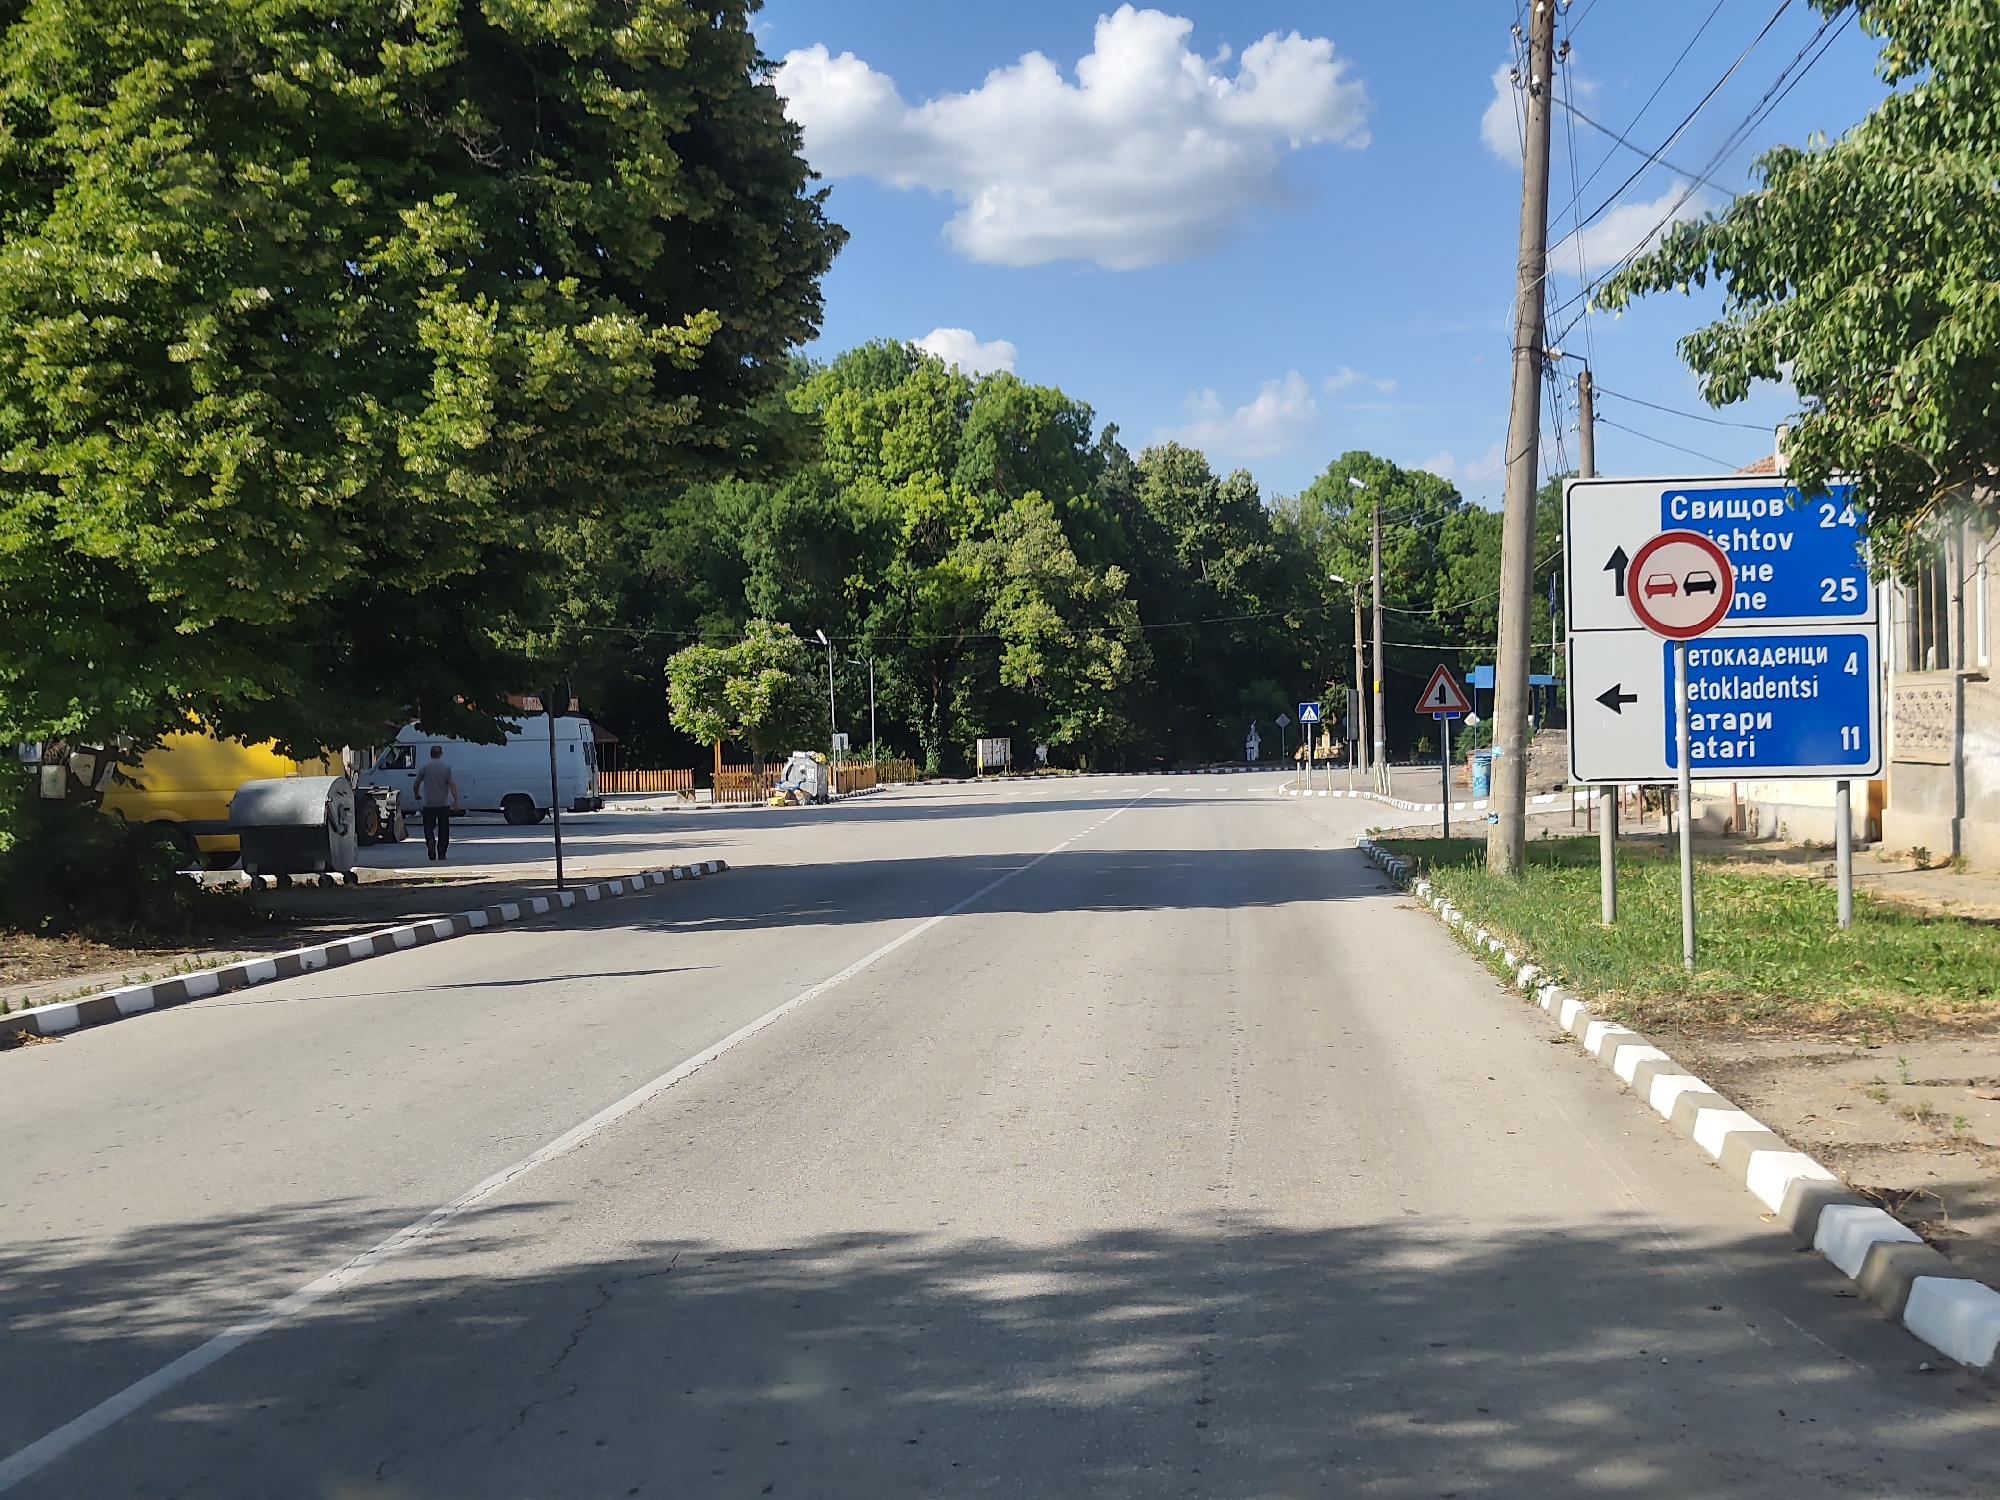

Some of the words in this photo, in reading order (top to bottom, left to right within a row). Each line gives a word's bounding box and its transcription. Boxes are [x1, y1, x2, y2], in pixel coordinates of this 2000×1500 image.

[1671, 495, 1784, 521] Свищов
[1819, 503, 1857, 528] 24
[1820, 577, 1858, 602] 25
[1674, 644, 1828, 668] етокладенци
[1843, 652, 1858, 676] 4
[1674, 675, 1818, 701] etokladentsi
[1675, 708, 1773, 736] атари
[1675, 735, 1756, 759] atari
[1840, 726, 1860, 750] 11
